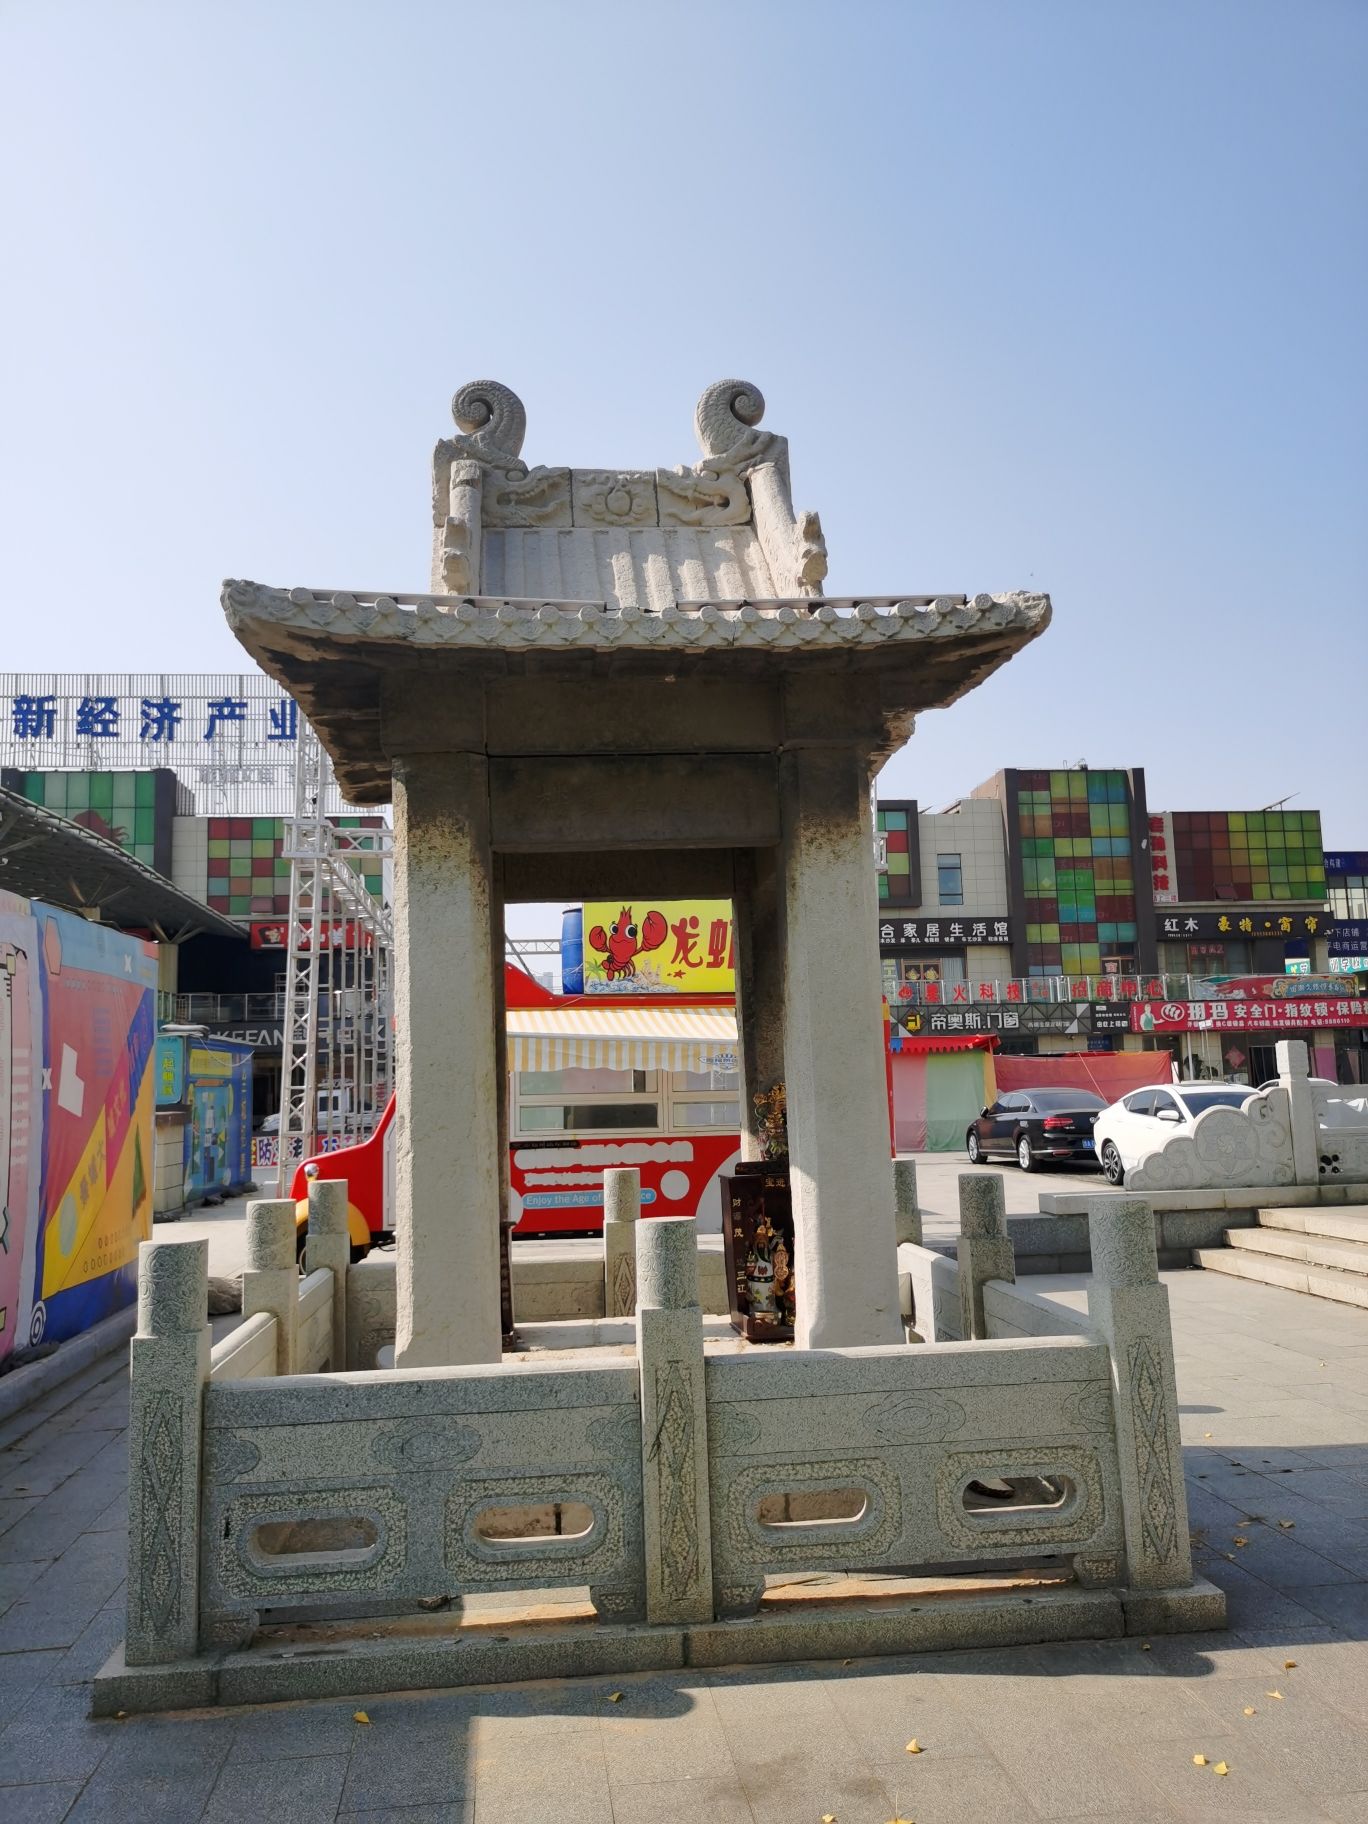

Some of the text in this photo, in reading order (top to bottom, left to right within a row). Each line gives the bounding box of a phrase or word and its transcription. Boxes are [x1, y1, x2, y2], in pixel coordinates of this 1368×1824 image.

[12, 694, 297, 742] 新经济产业
[880, 921, 1008, 938] 合家居生活馆
[1164, 917, 1199, 932] 红木
[1233, 1000, 1368, 1019] 安全门·指纹锁·保险
[526, 1194, 602, 1206] Enjoy the Age of
